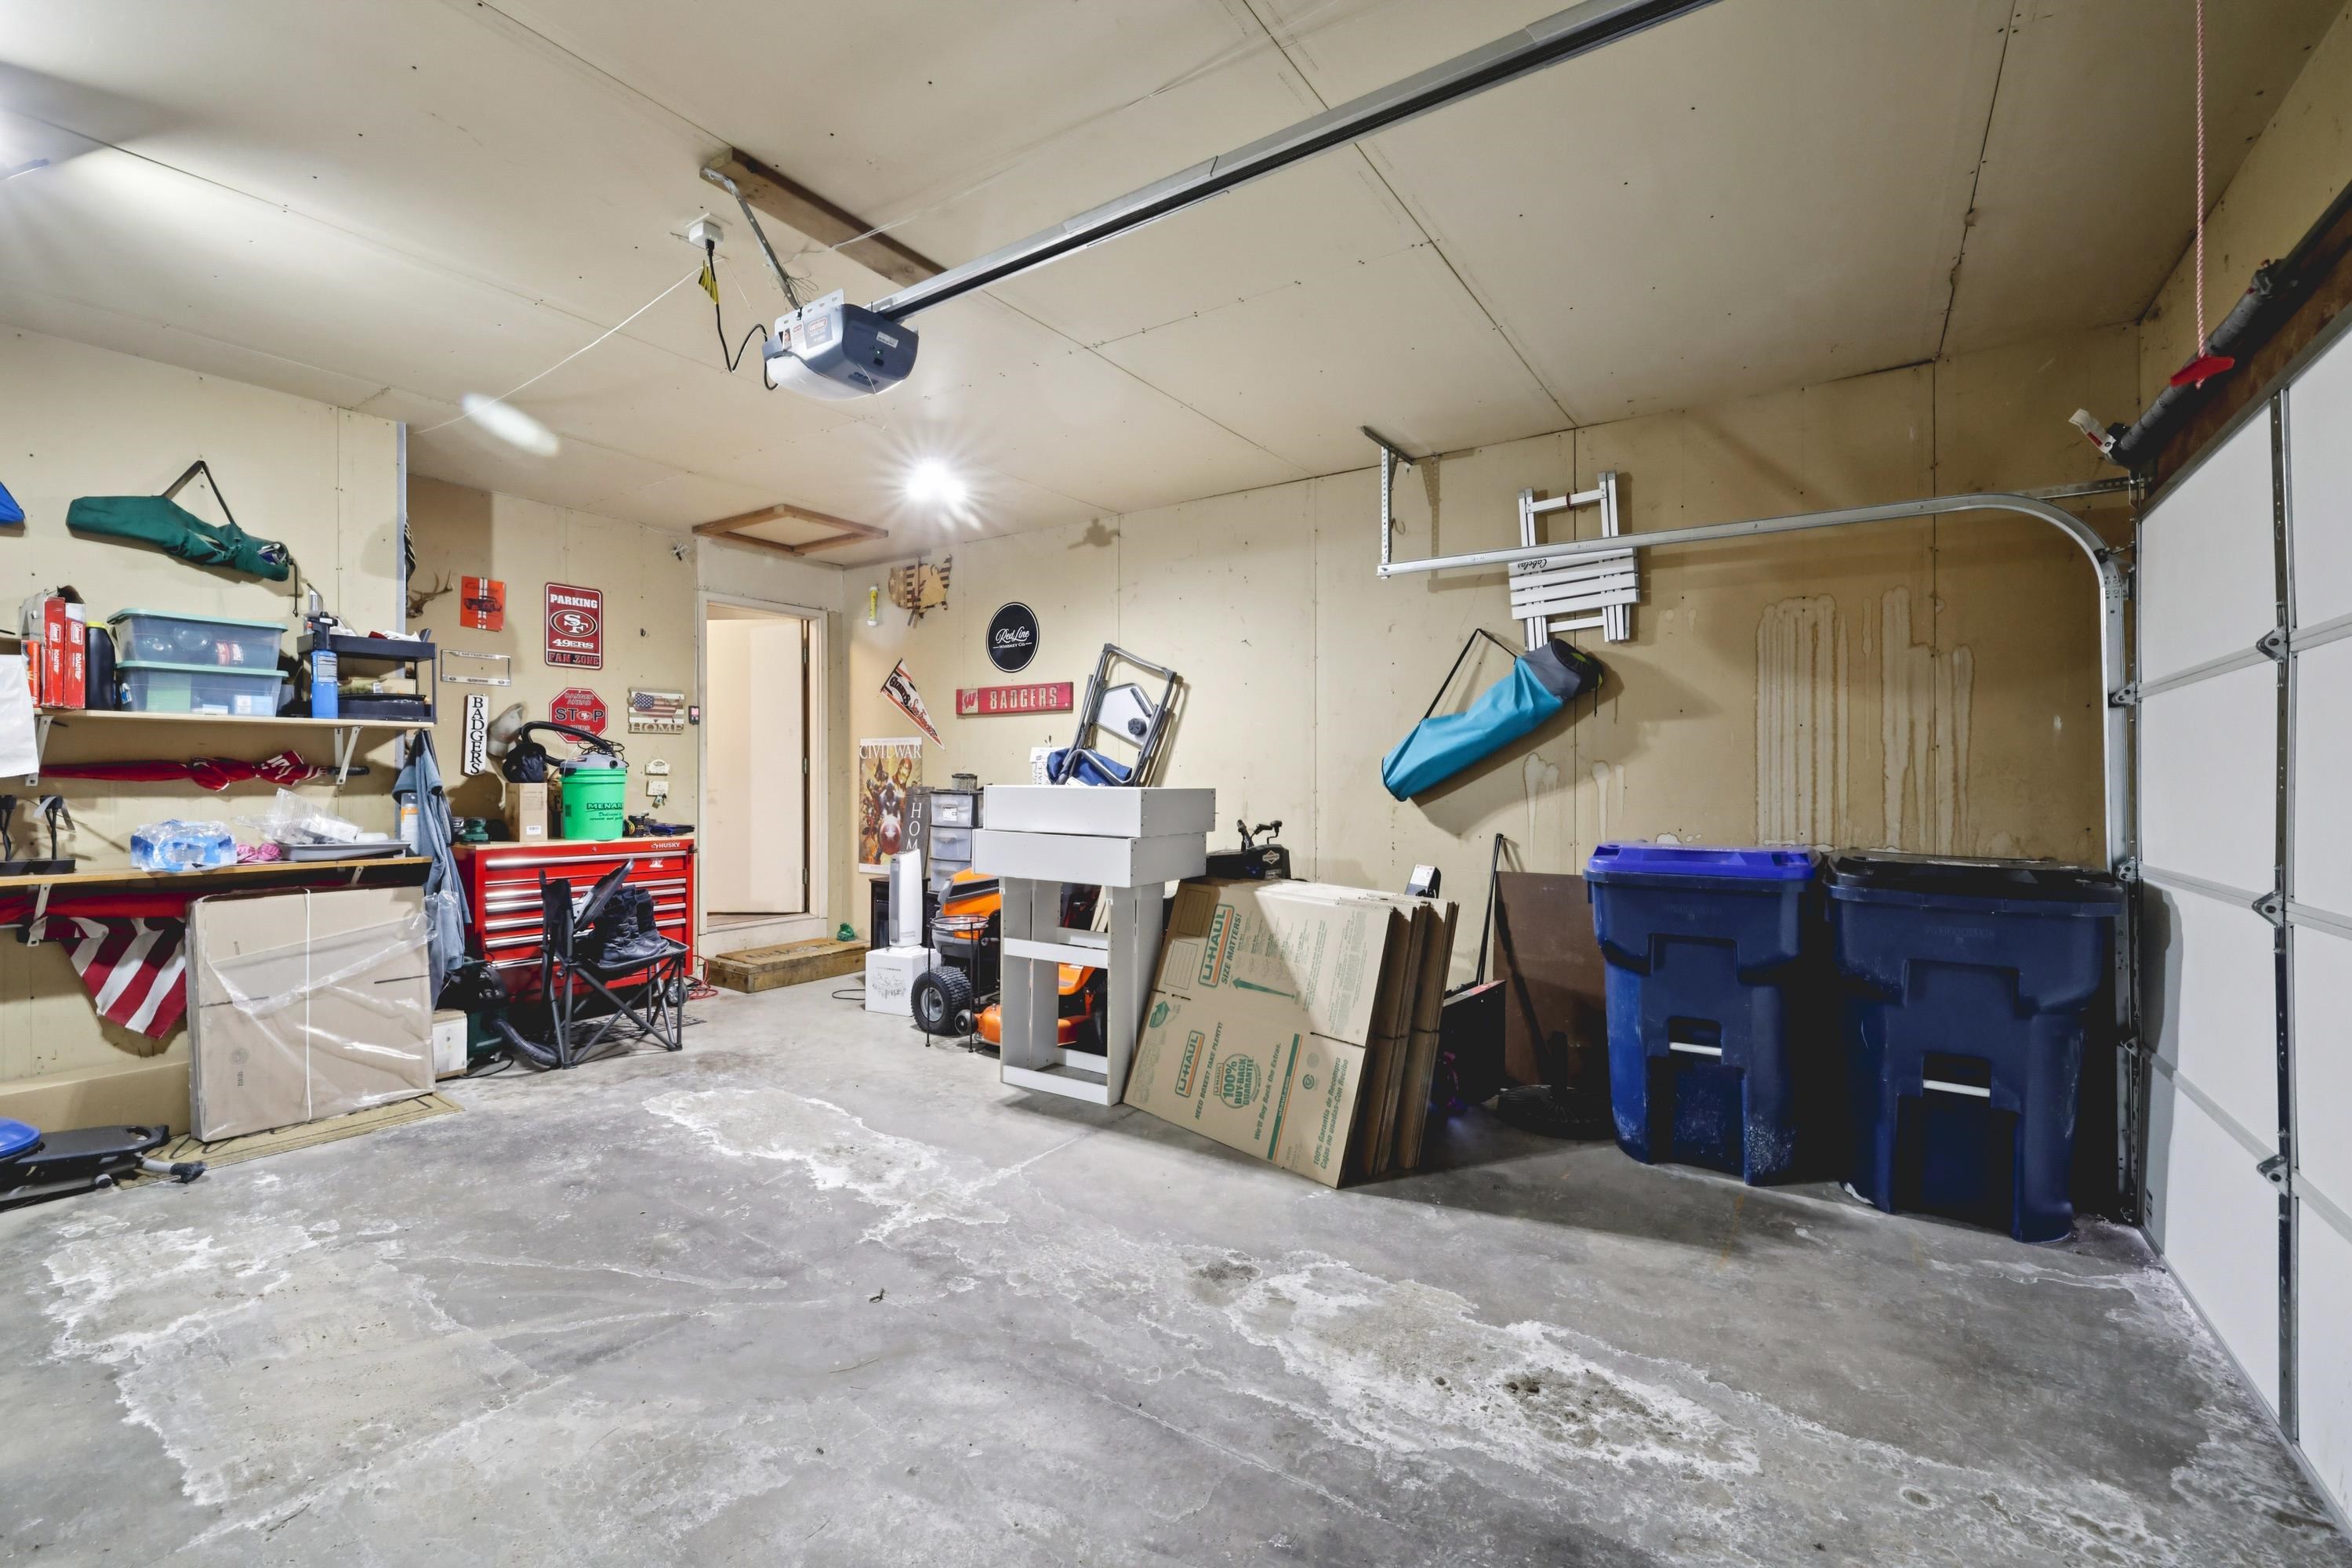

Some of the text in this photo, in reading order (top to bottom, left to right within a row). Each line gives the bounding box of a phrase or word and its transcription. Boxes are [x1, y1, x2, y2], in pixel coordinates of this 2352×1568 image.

[550, 593, 598, 609] PARKING
[564, 614, 589, 633] SF
[552, 638, 594, 649] 49ERS
[548, 652, 599, 666] FAN ZONE
[889, 676, 911, 706] GIANTS
[989, 686, 1058, 710] BADGERS
[470, 696, 485, 775] BADGERS
[630, 722, 684, 733] HOME
[859, 744, 922, 759] CIVIL WAR
[1202, 909, 1227, 981] U-HAUL
[1221, 913, 1243, 985] SIZE MATTERS!
[1178, 1036, 1199, 1091] U-HAUL
[1271, 1043, 1282, 1067] Extras.
[1194, 1022, 1223, 1120] NEED BOXES? TAKE PLENTY!
[1223, 1061, 1237, 1099] 100%
[1235, 1058, 1247, 1105] BUY-BACK
[1328, 1057, 1341, 1096] Recompra
[1263, 1083, 1272, 1104] Back
[1278, 1076, 1290, 1117] uhaul.com
[1326, 1097, 1333, 1108] de
[1259, 1105, 1268, 1120] Buy
[1320, 1059, 1348, 1170] Cajas no usadas-Con Recibo
[1254, 1120, 1264, 1141] We'll
[1313, 1144, 1323, 1166] 100%
